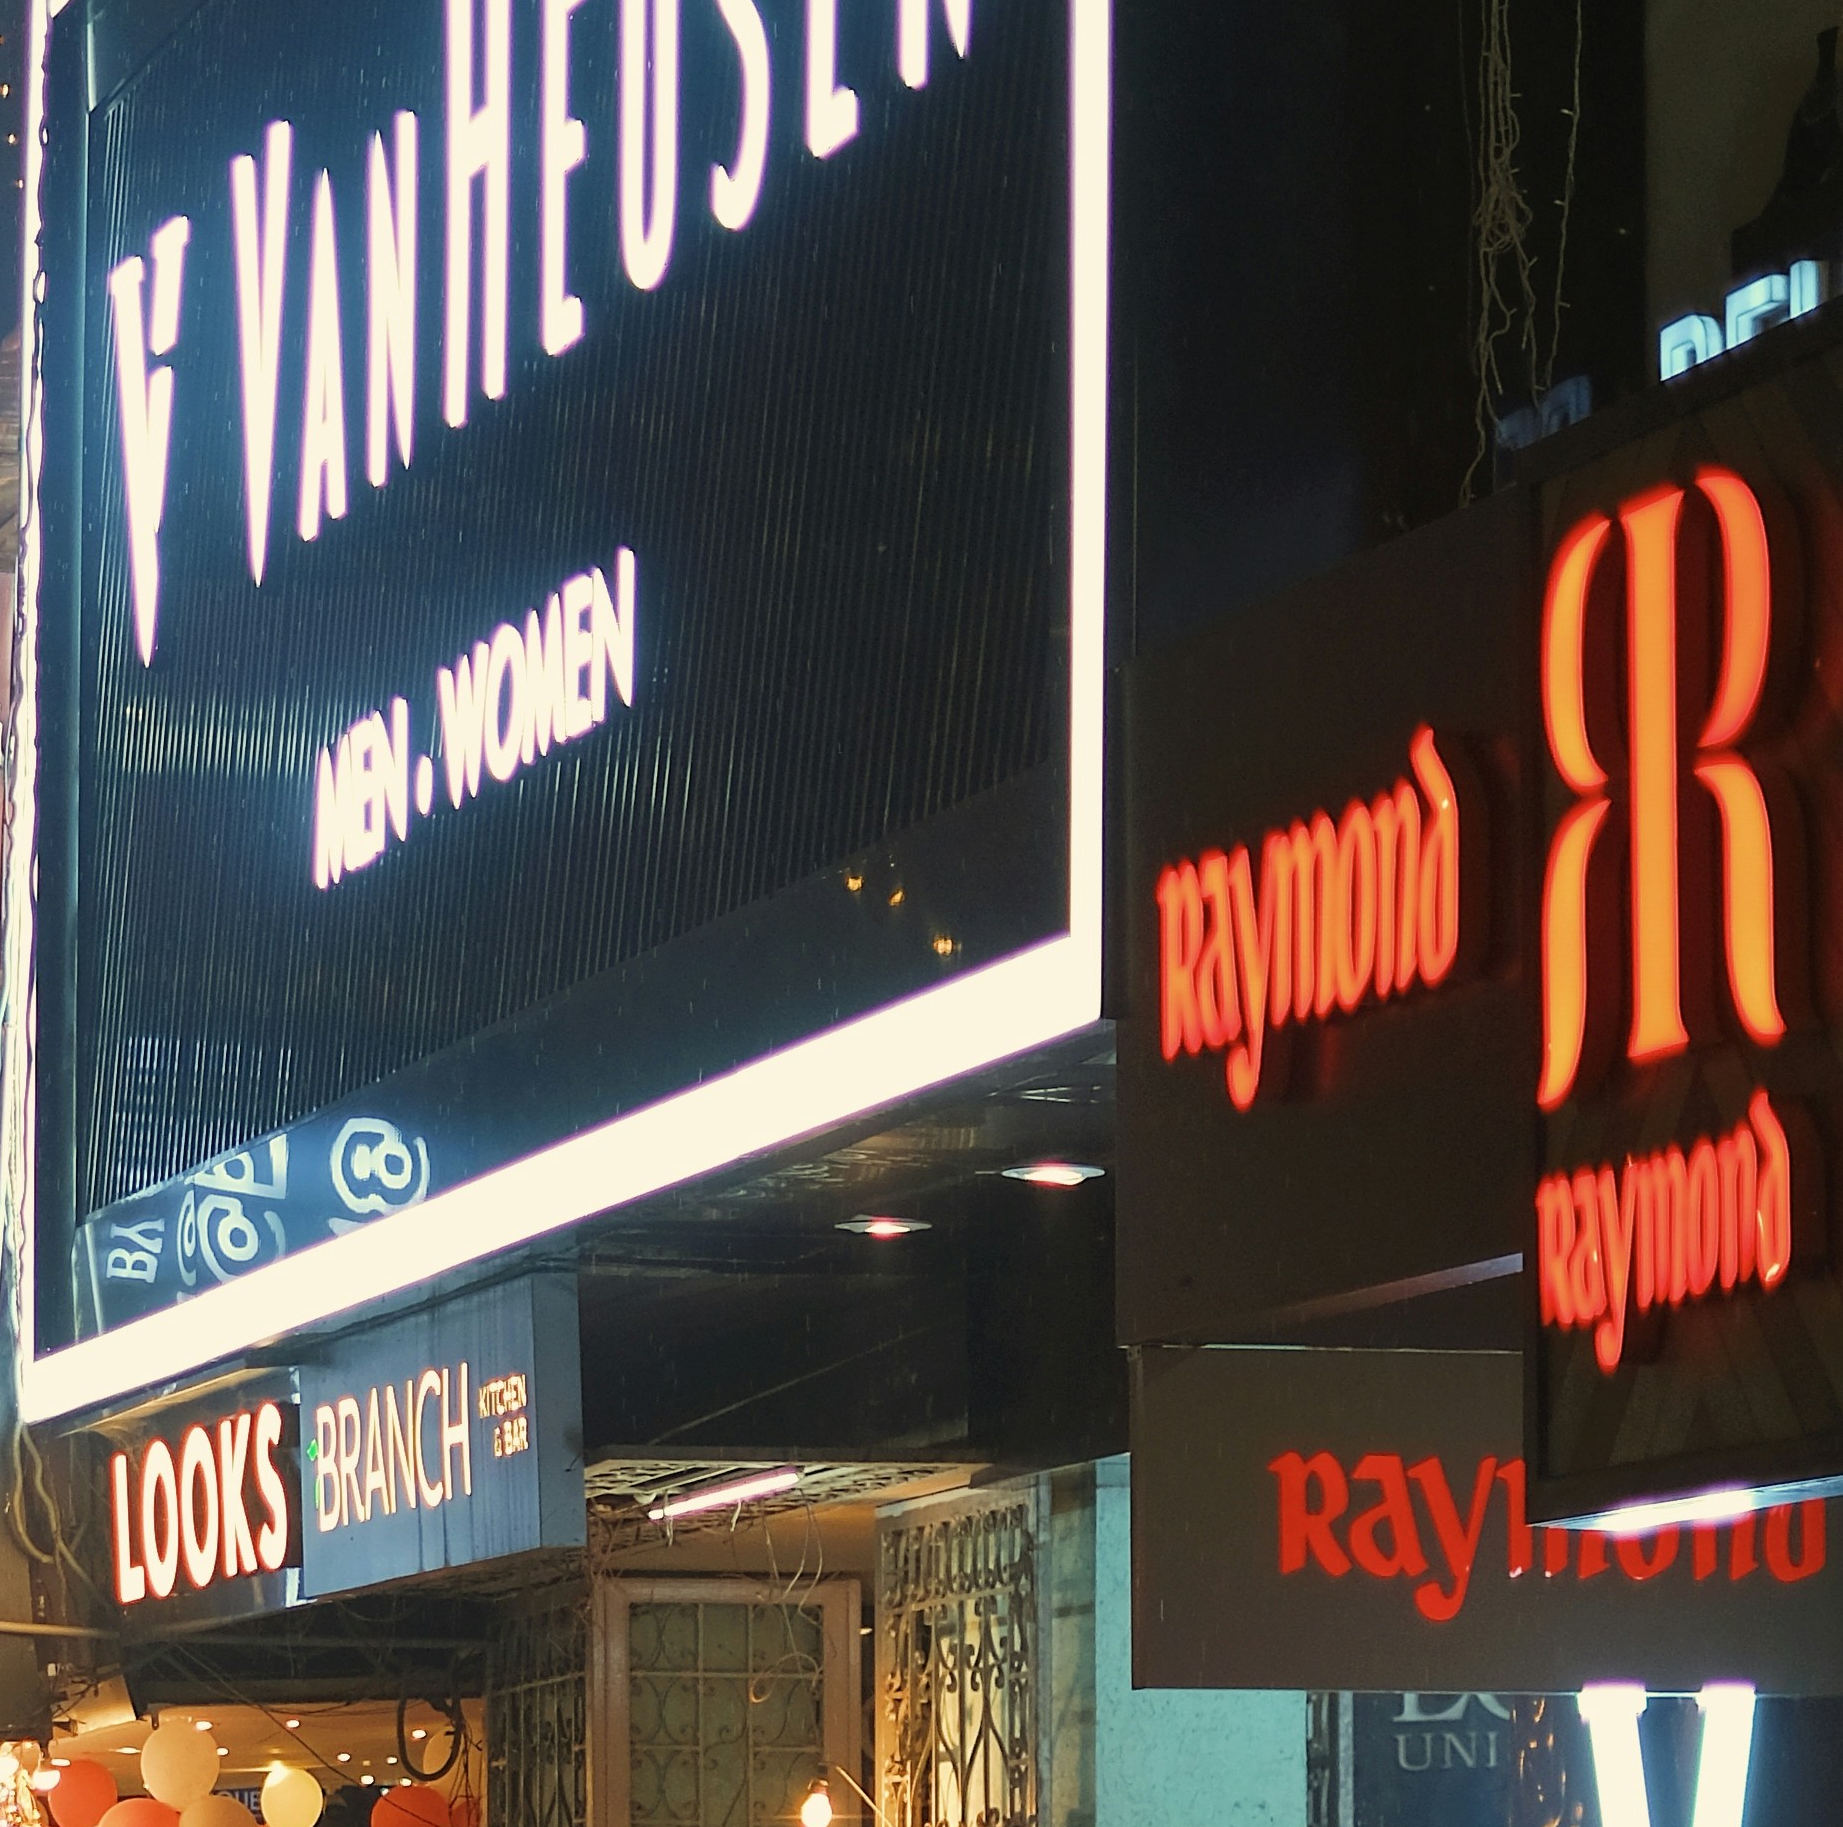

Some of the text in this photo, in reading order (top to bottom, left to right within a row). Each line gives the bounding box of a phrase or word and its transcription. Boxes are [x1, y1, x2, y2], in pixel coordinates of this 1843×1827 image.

[316, 1361, 473, 1533] BRANCH
[478, 1374, 527, 1419] KITCHEN
[503, 1416, 529, 1458] BAR
[109, 1400, 291, 1606] LOOKS
